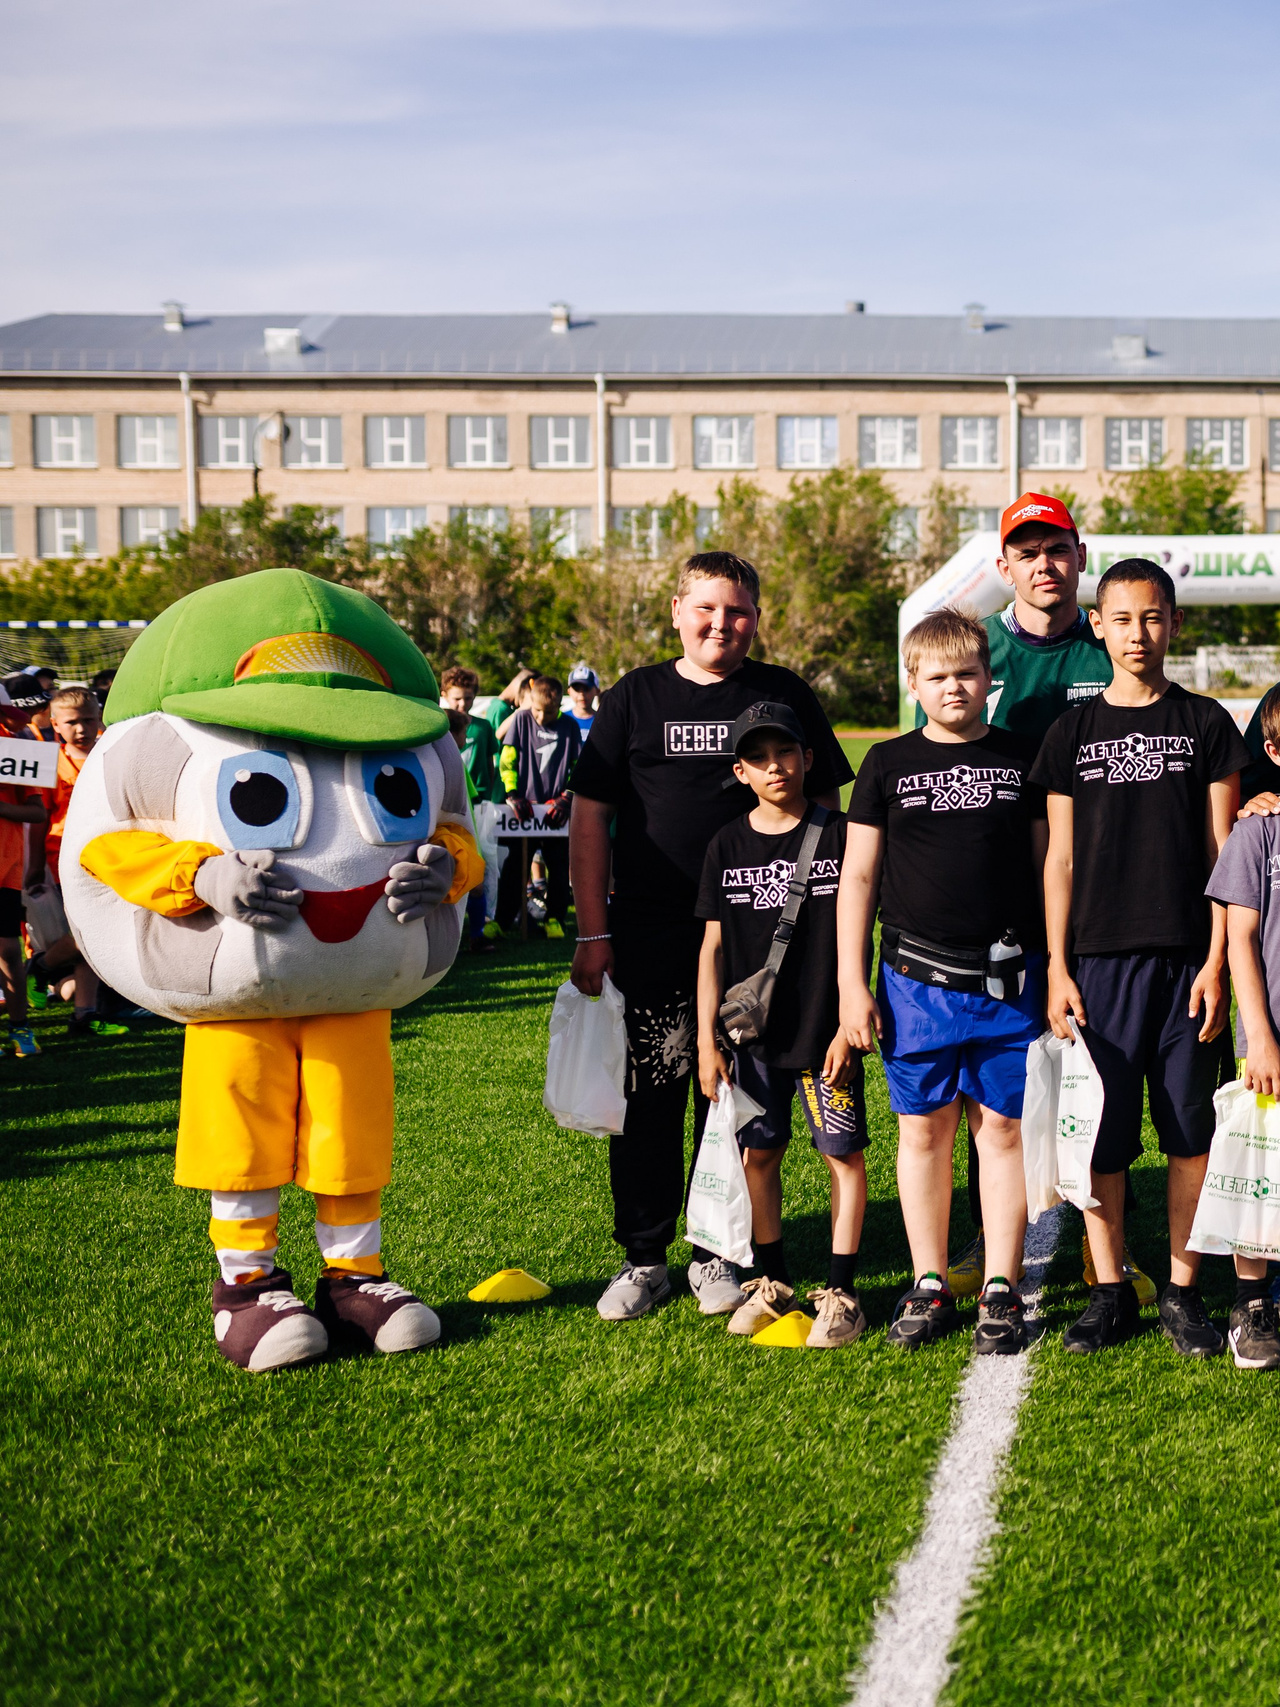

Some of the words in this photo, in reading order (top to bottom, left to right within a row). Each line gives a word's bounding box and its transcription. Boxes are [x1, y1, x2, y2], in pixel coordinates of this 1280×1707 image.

[670, 725, 728, 752] СЕВЕР
[1076, 733, 1194, 765] МЕТРОШКА
[896, 765, 1021, 794] МЕТРОШКА
[1107, 755, 1164, 784] 2025
[932, 784, 992, 811] 2025
[752, 884, 790, 910] 202
